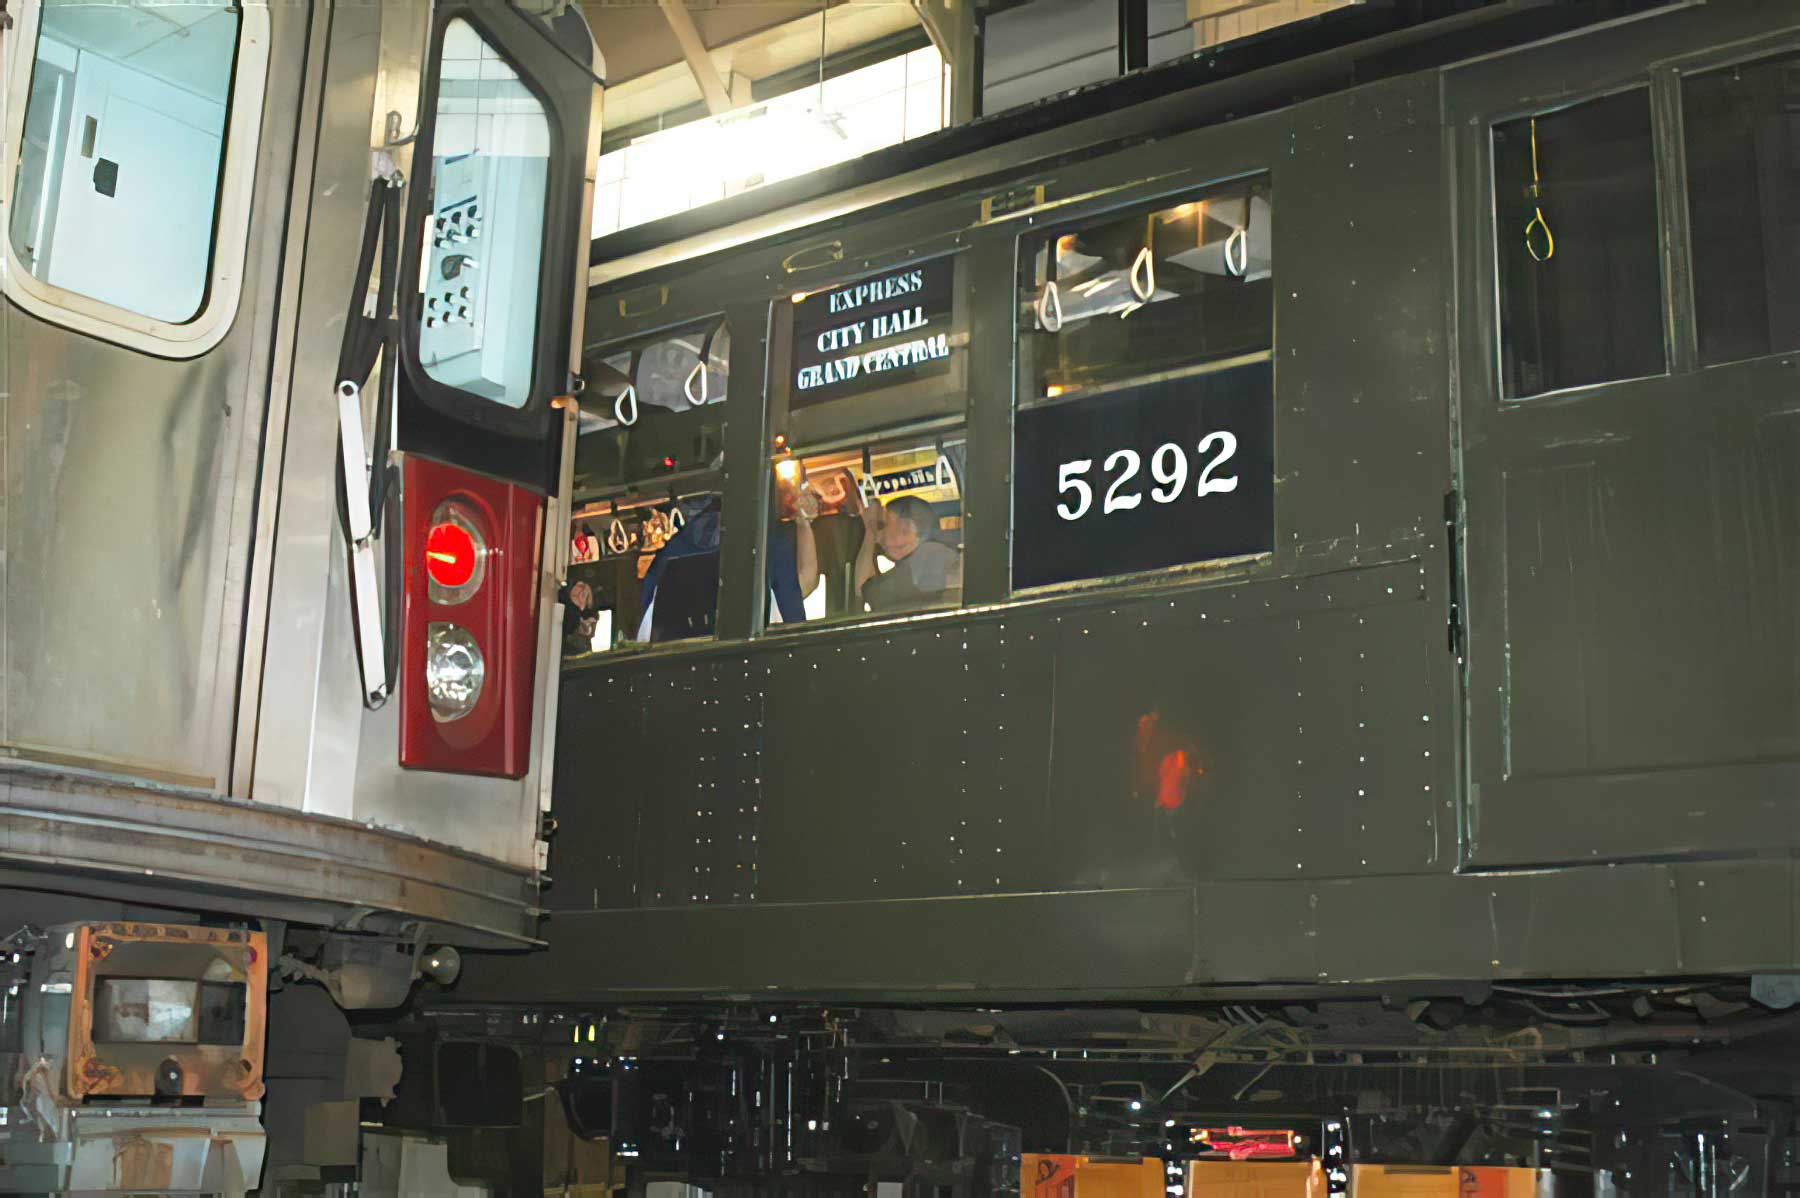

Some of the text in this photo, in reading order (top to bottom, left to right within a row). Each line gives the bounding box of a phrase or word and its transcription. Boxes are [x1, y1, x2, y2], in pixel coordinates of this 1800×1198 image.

[830, 269, 923, 314] EXPRESS
[817, 306, 929, 353] CITY HALL
[797, 333, 949, 390] GRAND CENTRAL
[1056, 430, 1239, 521] 5292
